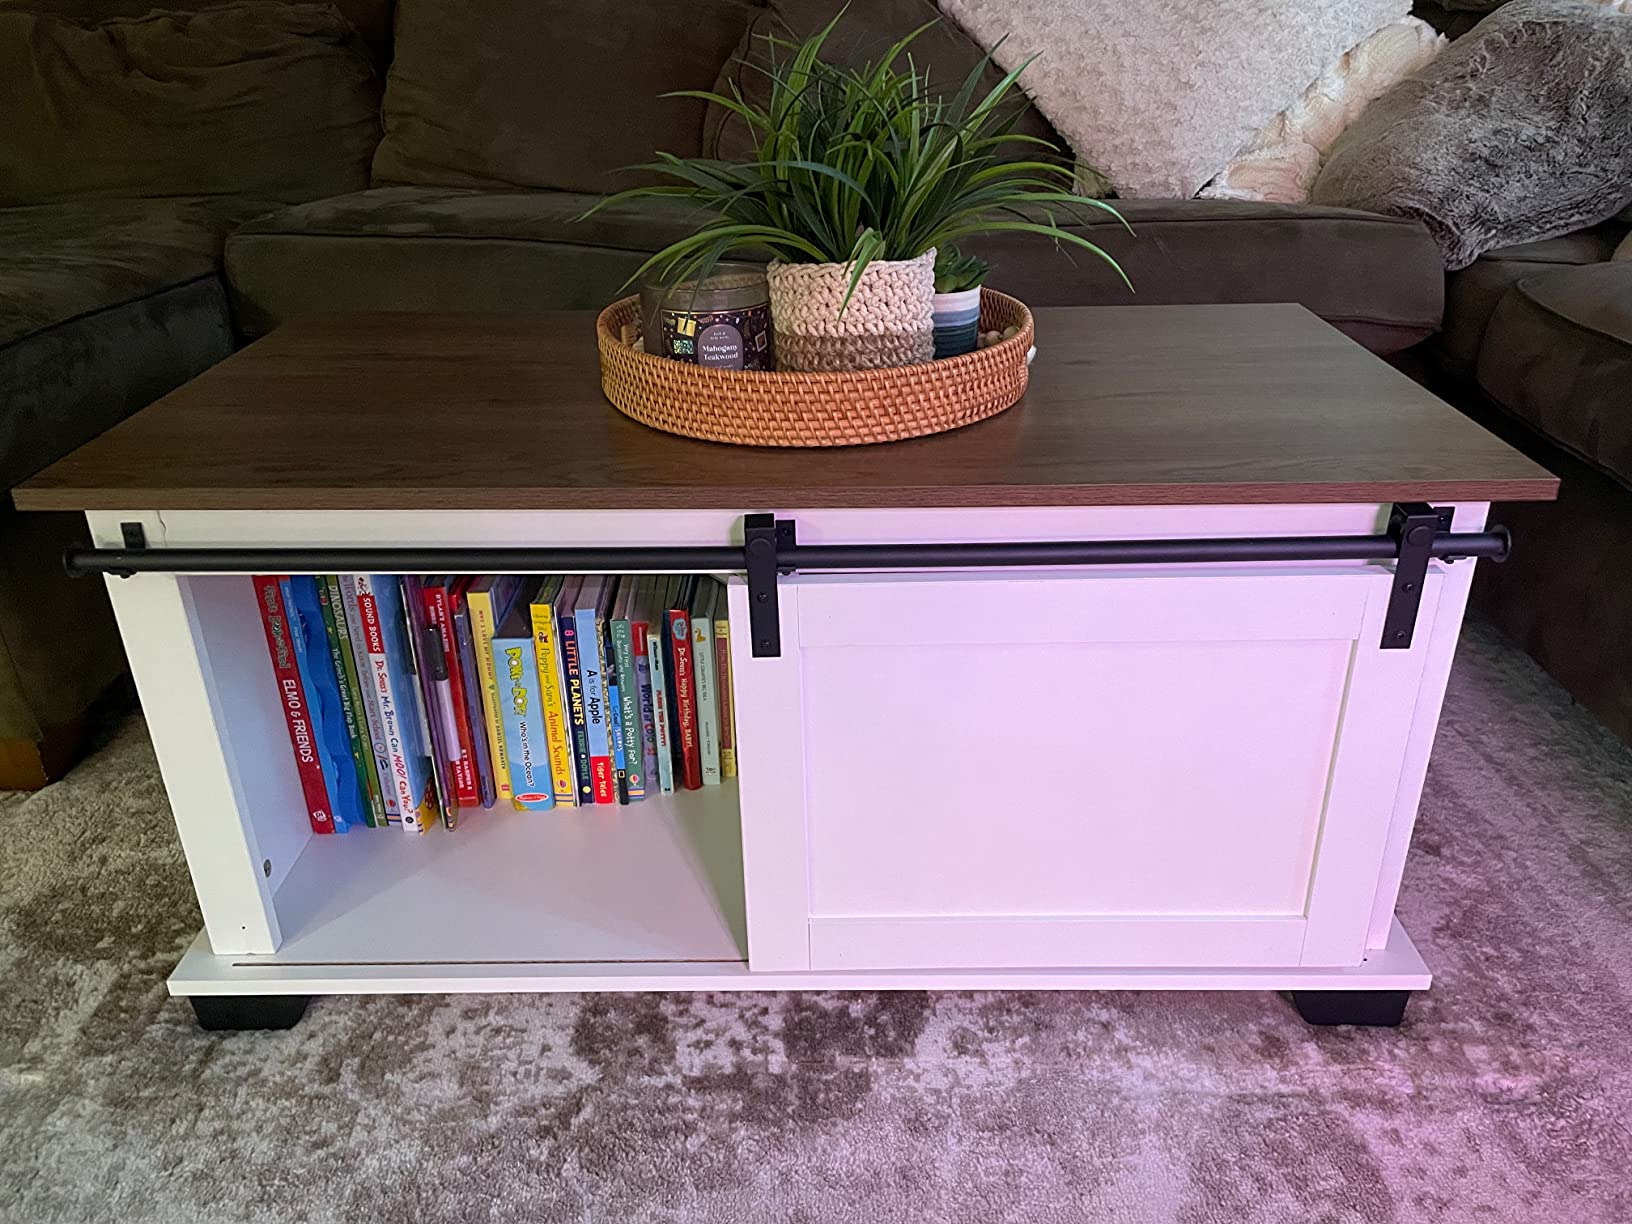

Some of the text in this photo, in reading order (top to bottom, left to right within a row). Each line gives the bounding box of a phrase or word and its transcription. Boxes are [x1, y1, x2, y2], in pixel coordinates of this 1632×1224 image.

[702, 345, 738, 353] Mahogany
[704, 352, 738, 360] Teakwood
[343, 583, 357, 612] Words
[435, 594, 444, 621] DYLAN'S
[328, 585, 348, 640] DINOSAURS
[363, 597, 381, 652] SOUND BOOKS
[375, 660, 384, 671] Dr.
[539, 647, 549, 674] Poppy
[564, 629, 584, 725] 8 LITTLE PLANETS
[587, 670, 597, 678] A
[343, 702, 351, 711] Big
[545, 685, 555, 707] Sam's
[623, 697, 633, 719] What's
[641, 684, 653, 712] World
[282, 679, 300, 709] ELMO
[292, 719, 313, 763] FRIENDS
[588, 697, 602, 724] Apple
[644, 714, 652, 722] of
[682, 699, 692, 728] Birthday,
[548, 711, 561, 742] Animal
[625, 727, 635, 748] Potty
[685, 729, 693, 747] BABY!
[381, 696, 413, 813] Mr. Brown Can MOO! Can You?
[519, 721, 528, 742] Who's
[525, 762, 534, 787] Ocean?
[553, 745, 566, 775] Sounds
[629, 750, 637, 765] For?
[455, 765, 464, 788] TAYLOR
[580, 759, 589, 780] DOYLE
[596, 762, 606, 779] tiger
